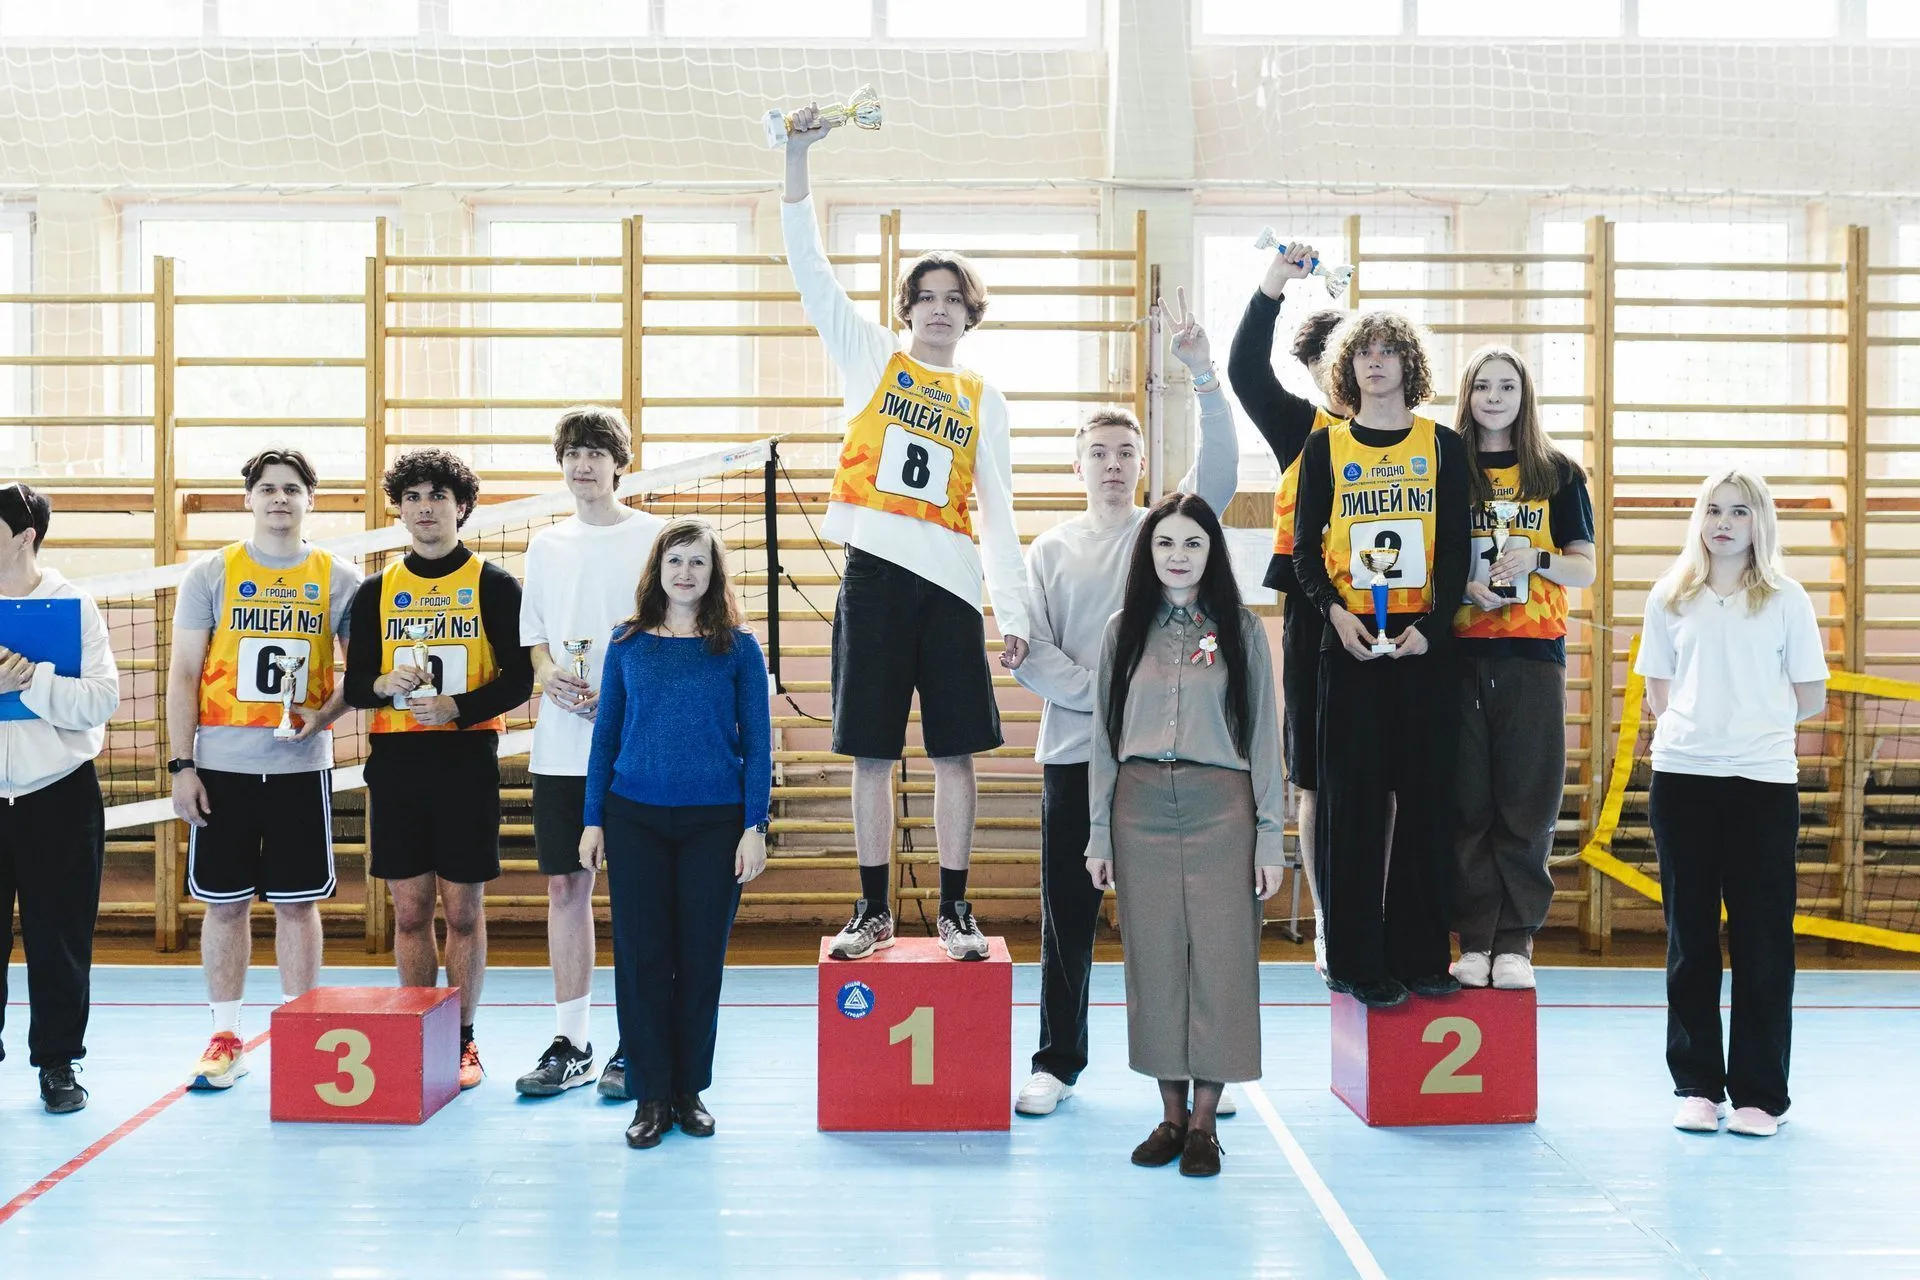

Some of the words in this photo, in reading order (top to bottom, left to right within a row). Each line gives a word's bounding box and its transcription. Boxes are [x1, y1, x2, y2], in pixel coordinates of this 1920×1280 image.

[921, 386, 952, 404] ГРОДНО
[879, 391, 942, 434] ЛИЦЕЙ
[943, 416, 974, 448] №1
[901, 442, 931, 489] 8
[1371, 465, 1405, 478] ГРОДНО
[1340, 483, 1403, 518] ЛИЦЕЙ
[1407, 487, 1433, 513] №1
[1491, 487, 1515, 497] ОДНО
[1515, 504, 1543, 531] №1
[1374, 530, 1403, 579] 2
[265, 588, 297, 599] ГРОДНО
[420, 596, 451, 607] ГРОДНО
[230, 605, 293, 634] ЛИЦЕЙ
[297, 610, 324, 635] №1
[451, 615, 479, 638] №1
[256, 645, 287, 695] 6
[889, 1006, 934, 1085] 1
[1420, 1016, 1483, 1094] 2
[314, 1028, 376, 1107] 3
